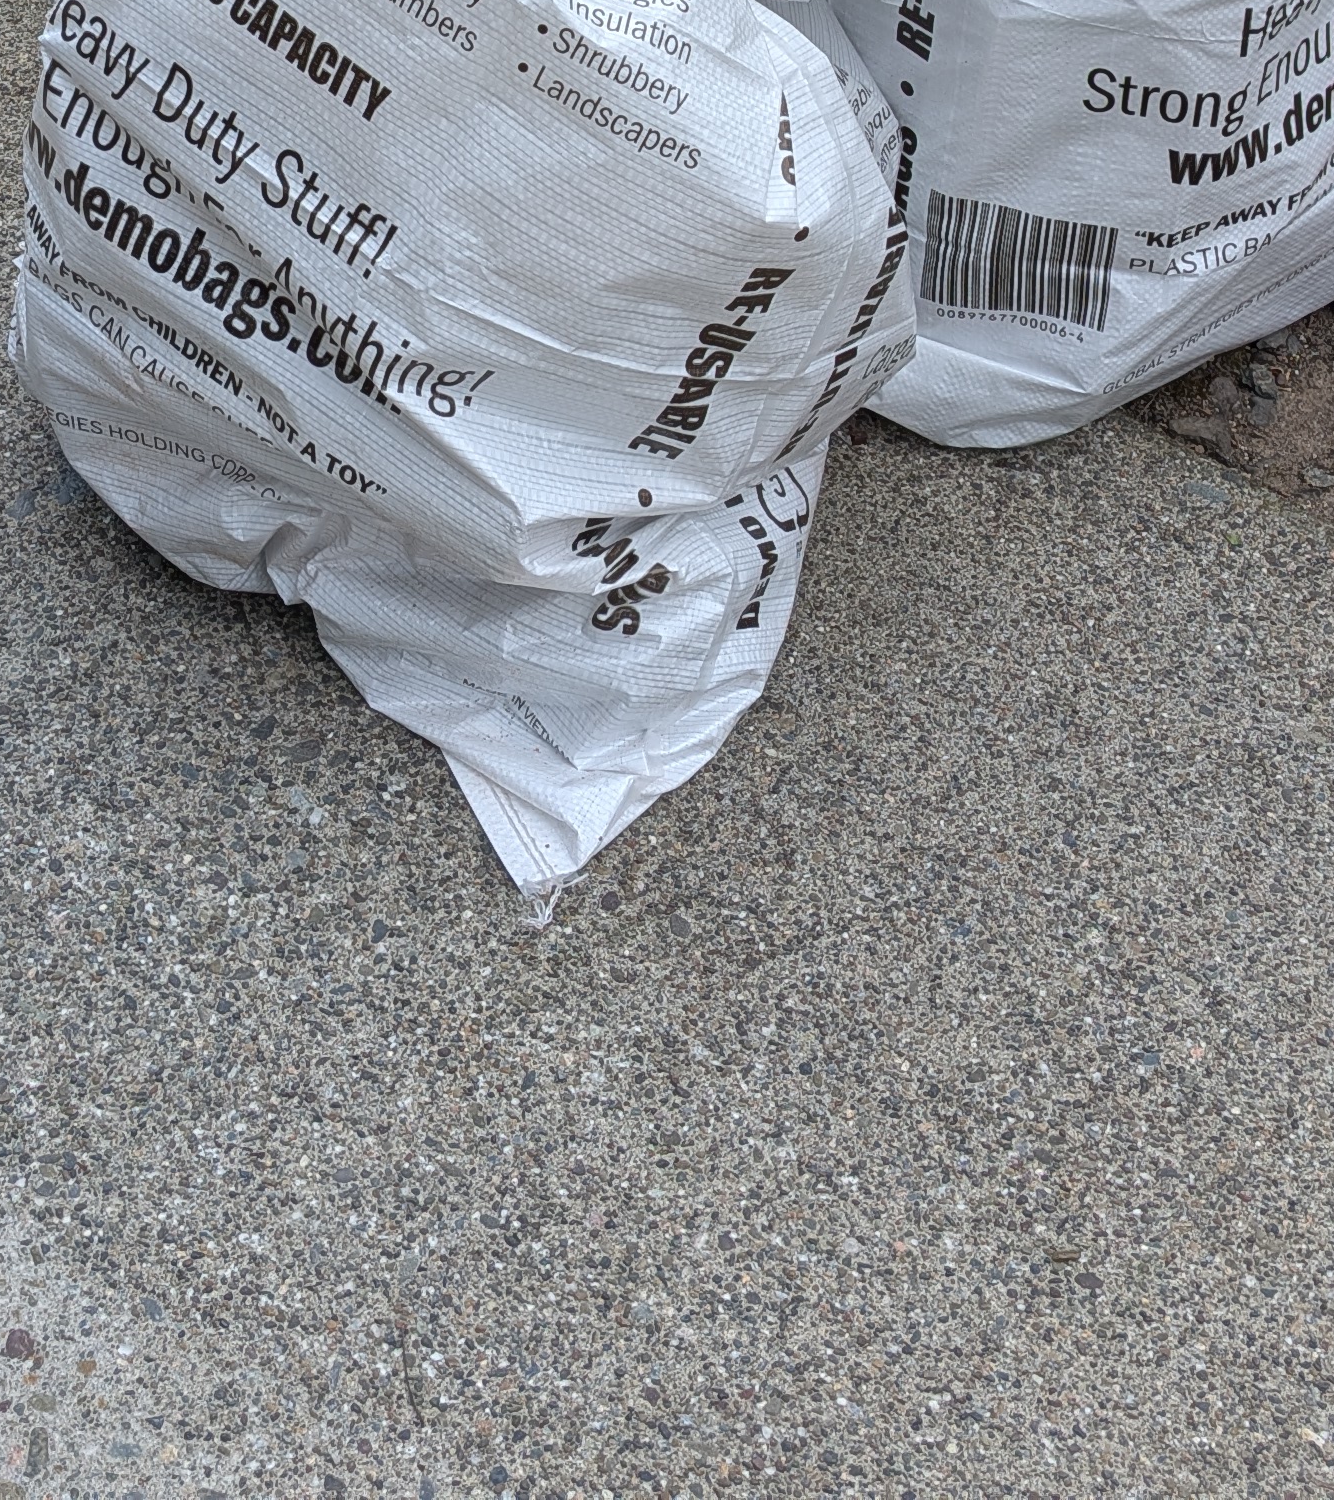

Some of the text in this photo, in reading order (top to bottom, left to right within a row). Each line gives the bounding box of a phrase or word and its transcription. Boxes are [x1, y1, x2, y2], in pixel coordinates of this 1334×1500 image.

[552, 27, 690, 116] Shrubbery
[1081, 67, 1253, 138] Strong
[533, 65, 702, 170] Landscapers
[151, 61, 261, 185] Duty
[261, 148, 399, 280] Stuff!
[1212, 196, 1283, 231] AWAY
[1128, 241, 1238, 277] PLASTIC
[26, 204, 61, 265] AWAY
[59, 259, 128, 310] FROM
[131, 305, 245, 397] CHILDREN
[256, 393, 300, 445] NOT
[299, 441, 327, 464] A
[88, 304, 129, 351] CAN
[627, 266, 797, 461] RE-USABLE
[1102, 357, 1165, 395] GLOBAL
[1167, 299, 1254, 358] STRATEGIES
[108, 424, 207, 463] HOLDING
